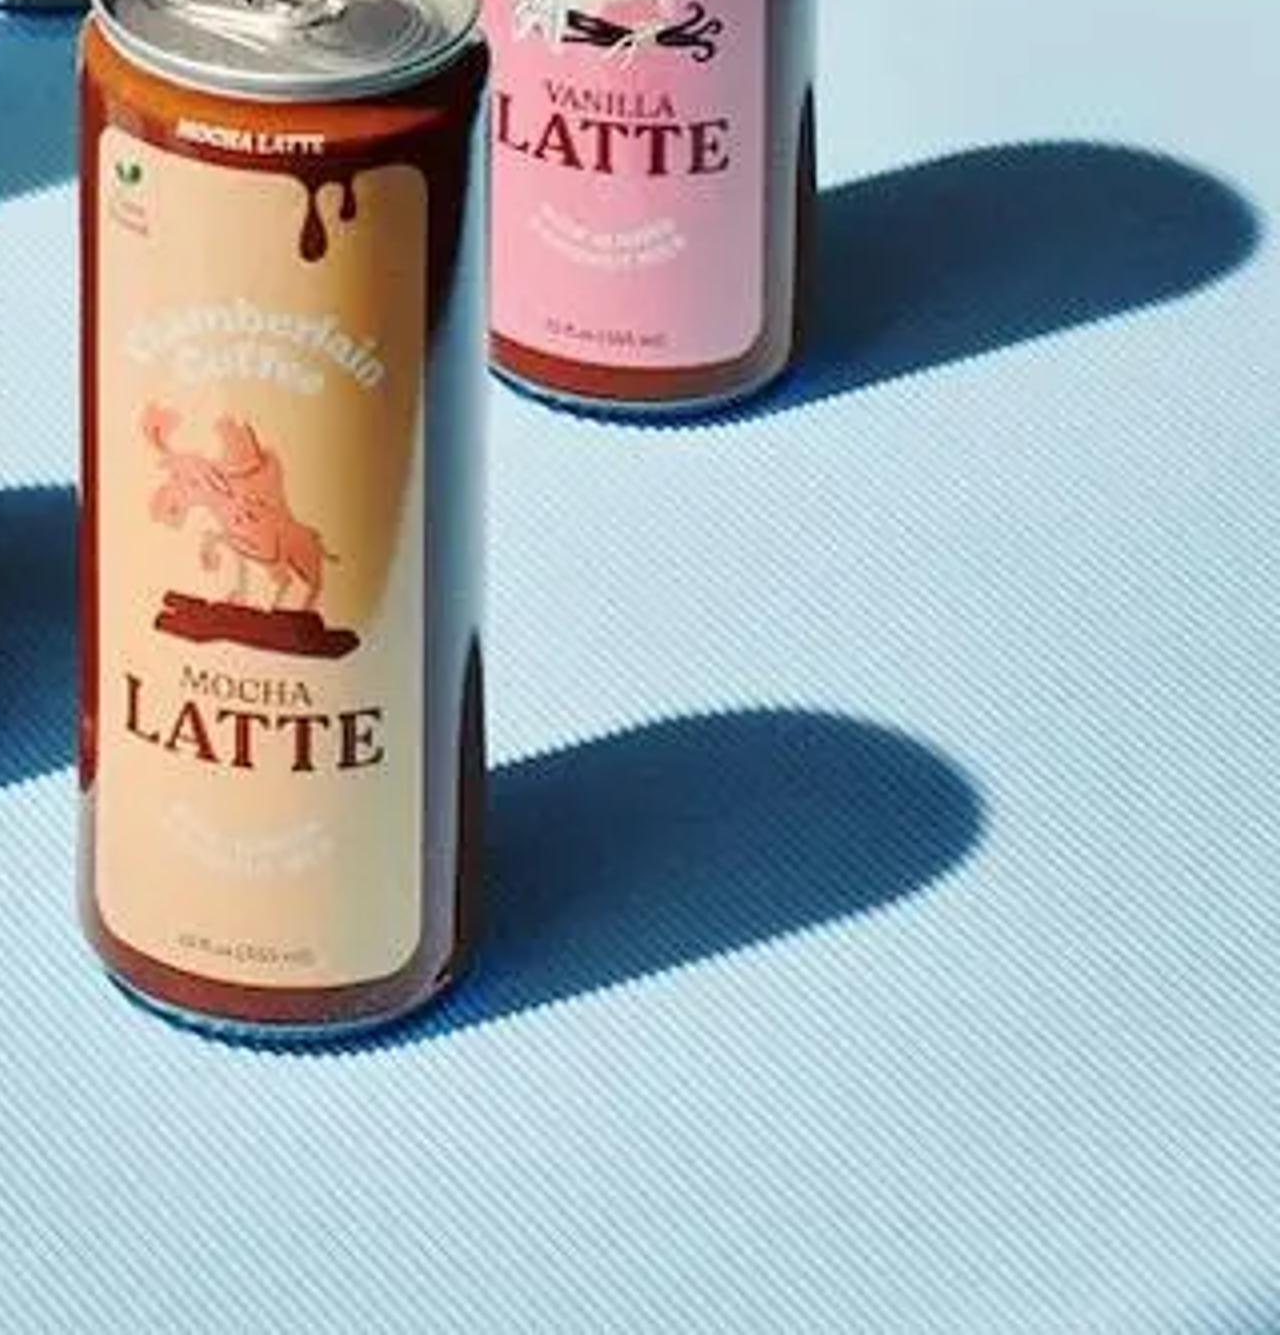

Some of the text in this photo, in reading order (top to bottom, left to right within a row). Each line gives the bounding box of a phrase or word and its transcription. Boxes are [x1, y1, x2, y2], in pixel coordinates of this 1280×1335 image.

[545, 79, 677, 120] VANILLA
[175, 117, 326, 156] MOCHA LATTE
[496, 92, 730, 176] LATTE
[180, 665, 313, 707] MOCHA
[124, 673, 386, 773] LATTE
